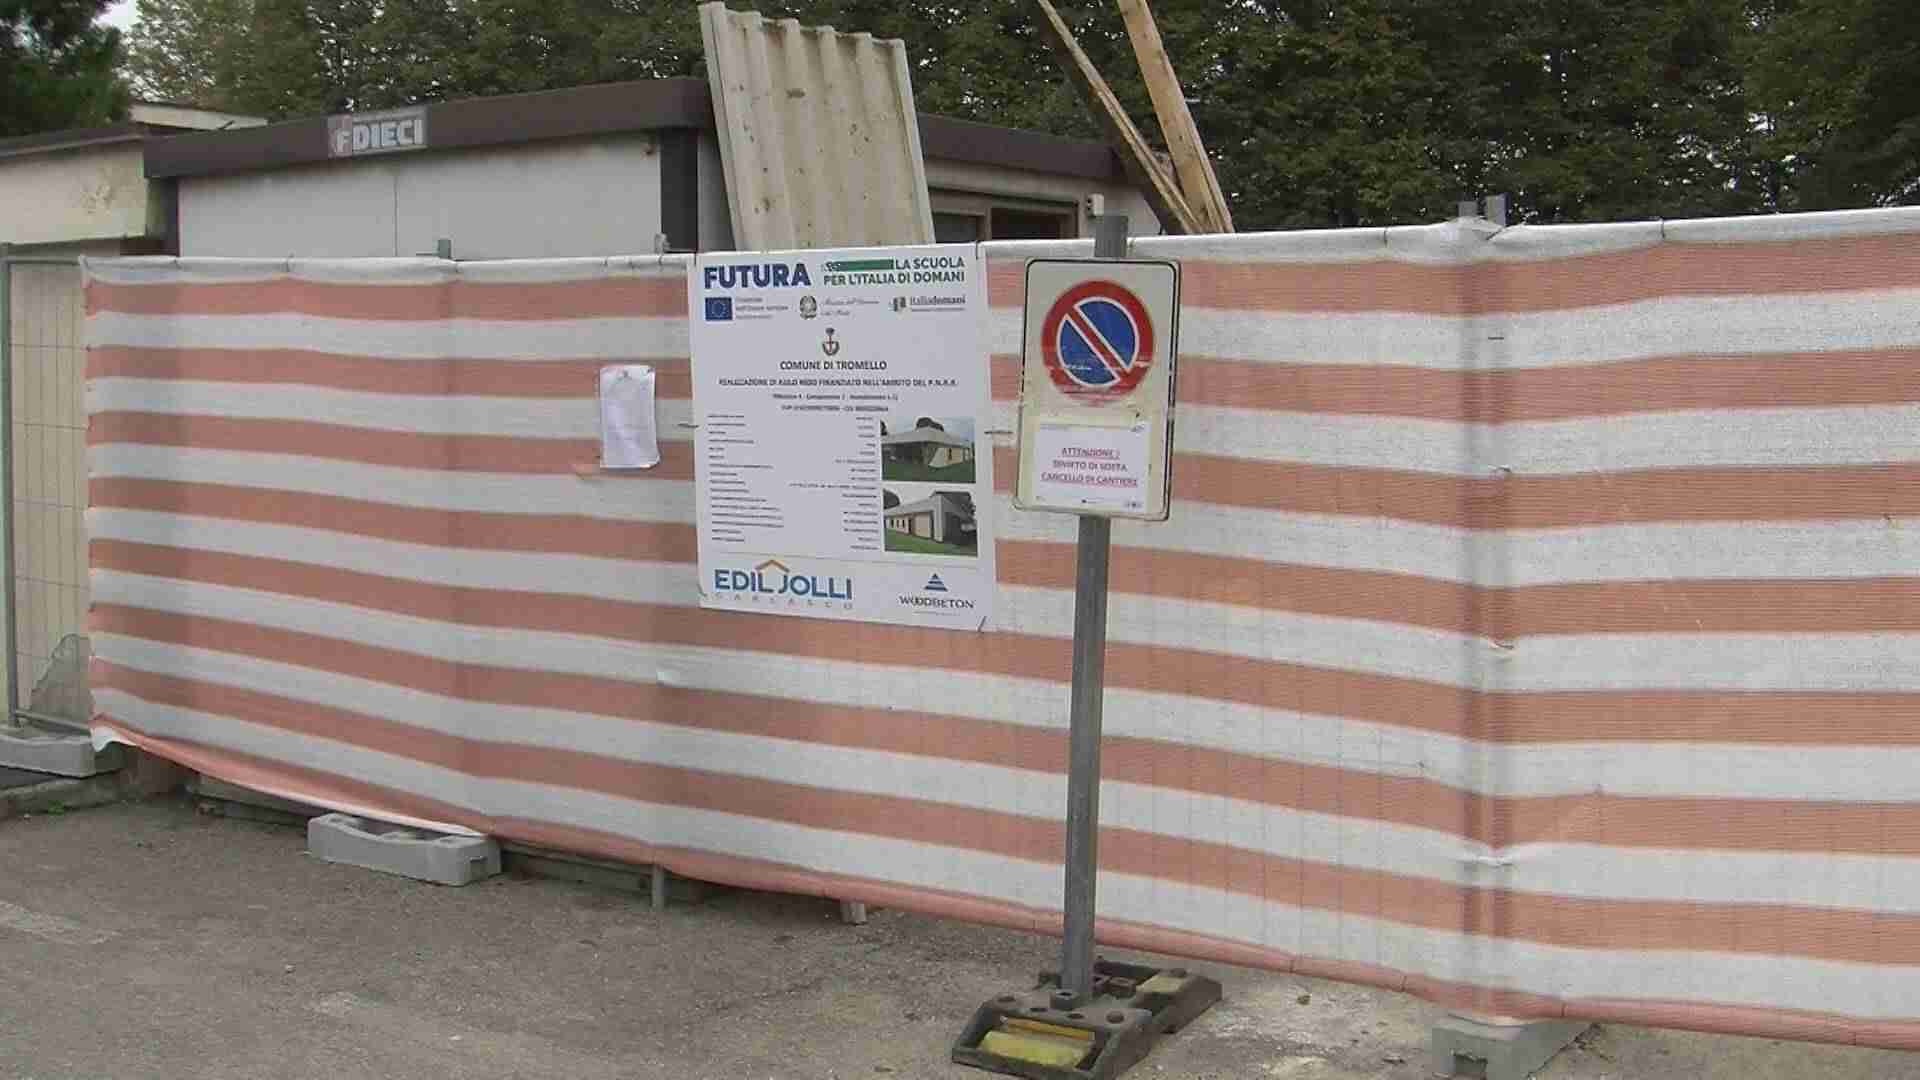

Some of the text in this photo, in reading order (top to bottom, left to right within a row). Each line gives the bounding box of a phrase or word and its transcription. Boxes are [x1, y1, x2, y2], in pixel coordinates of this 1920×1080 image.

[895, 257, 965, 270] LA SCUOLA
[704, 264, 811, 289] FUTURA
[823, 271, 965, 285] PER L'ITALIA DI DOMANI
[780, 361, 888, 370] COMUNE DI TROMELLO
[1052, 460, 1128, 472] DIVIETO DI SOSTA
[1040, 471, 1084, 482] CANCELLO
[714, 569, 853, 600] EDIL JOLLI
